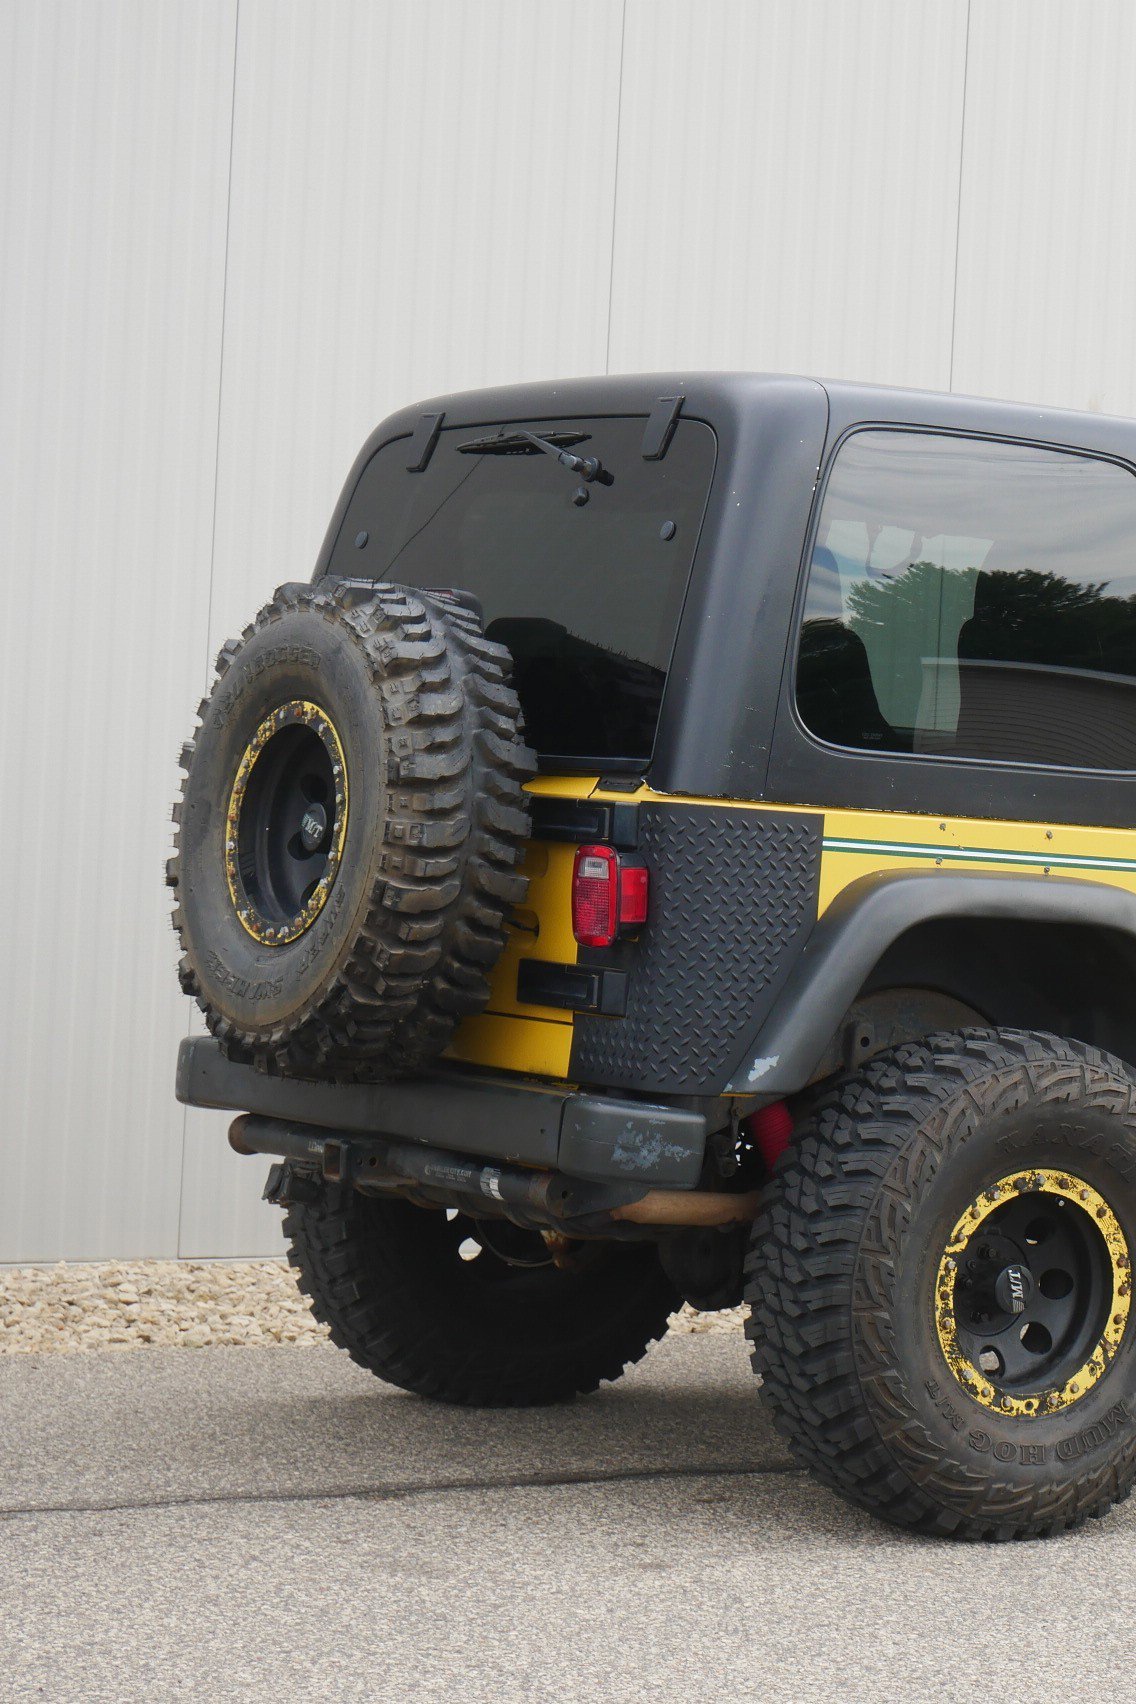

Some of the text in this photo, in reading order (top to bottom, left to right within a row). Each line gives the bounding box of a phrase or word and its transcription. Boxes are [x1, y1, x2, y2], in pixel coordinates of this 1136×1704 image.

[924, 1378, 1132, 1465] MUD HOG M/T
